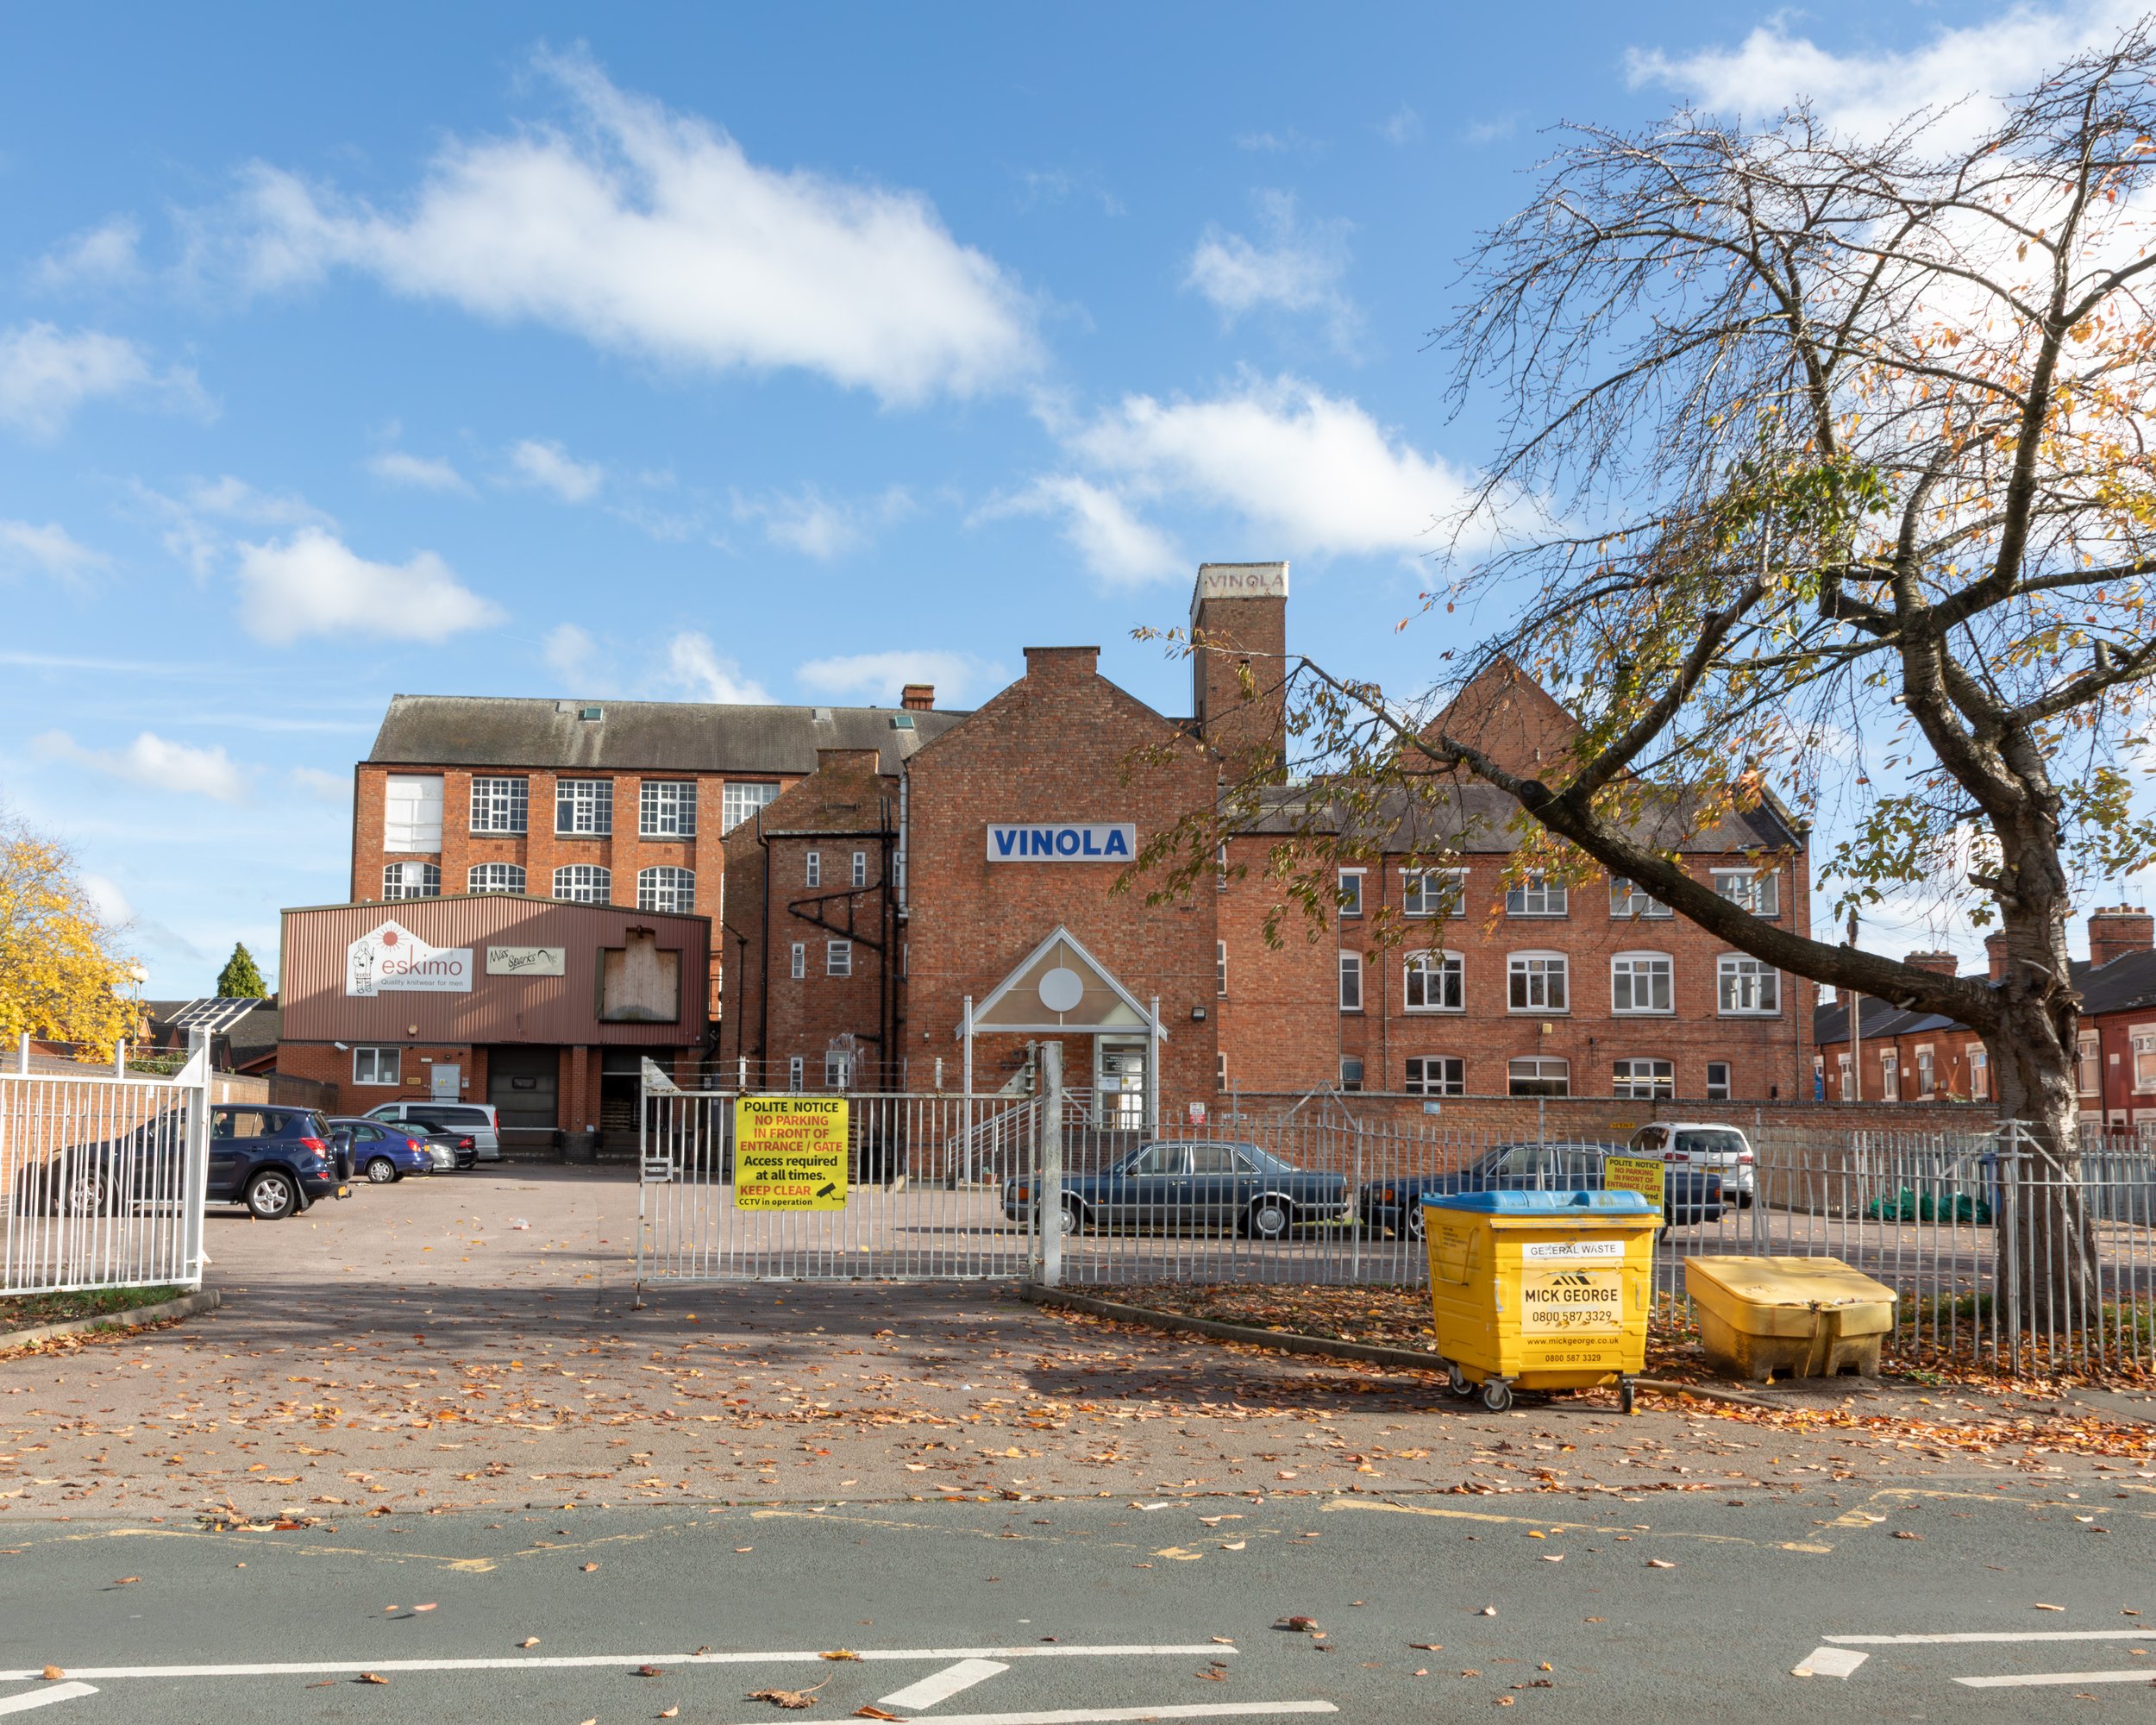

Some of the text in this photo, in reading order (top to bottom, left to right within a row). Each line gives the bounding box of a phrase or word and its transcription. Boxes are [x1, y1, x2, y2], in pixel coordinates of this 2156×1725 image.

[1209, 574, 1283, 587] VINOLA
[994, 829, 1128, 856] VINOLA
[382, 944, 462, 975] eskimo
[490, 950, 509, 963] Miss
[508, 951, 536, 969] Sparks
[743, 1101, 839, 1113] POLITE NOTICE
[755, 1115, 829, 1126] NO PARKING
[754, 1128, 830, 1138] IN FRONT OF
[740, 1141, 804, 1151] ENTRANCE
[813, 1141, 843, 1151] GATE
[743, 1155, 837, 1169] Access required
[1635, 1161, 1660, 1170] NOTICE
[755, 1170, 826, 1181] at all times.
[1625, 1168, 1654, 1176] PARKING
[740, 1185, 812, 1195] KEEP CLEAR
[1607, 1181, 1640, 1190] ENTRANCE
[772, 1198, 812, 1207] operation
[1530, 1245, 1616, 1256] GEERAL WASTE
[1526, 1289, 1618, 1302] MICK GEORGE
[1532, 1311, 1612, 1322] 0800 587 3329
[1526, 1337, 1620, 1346] www.mickgeorge.co.uk
